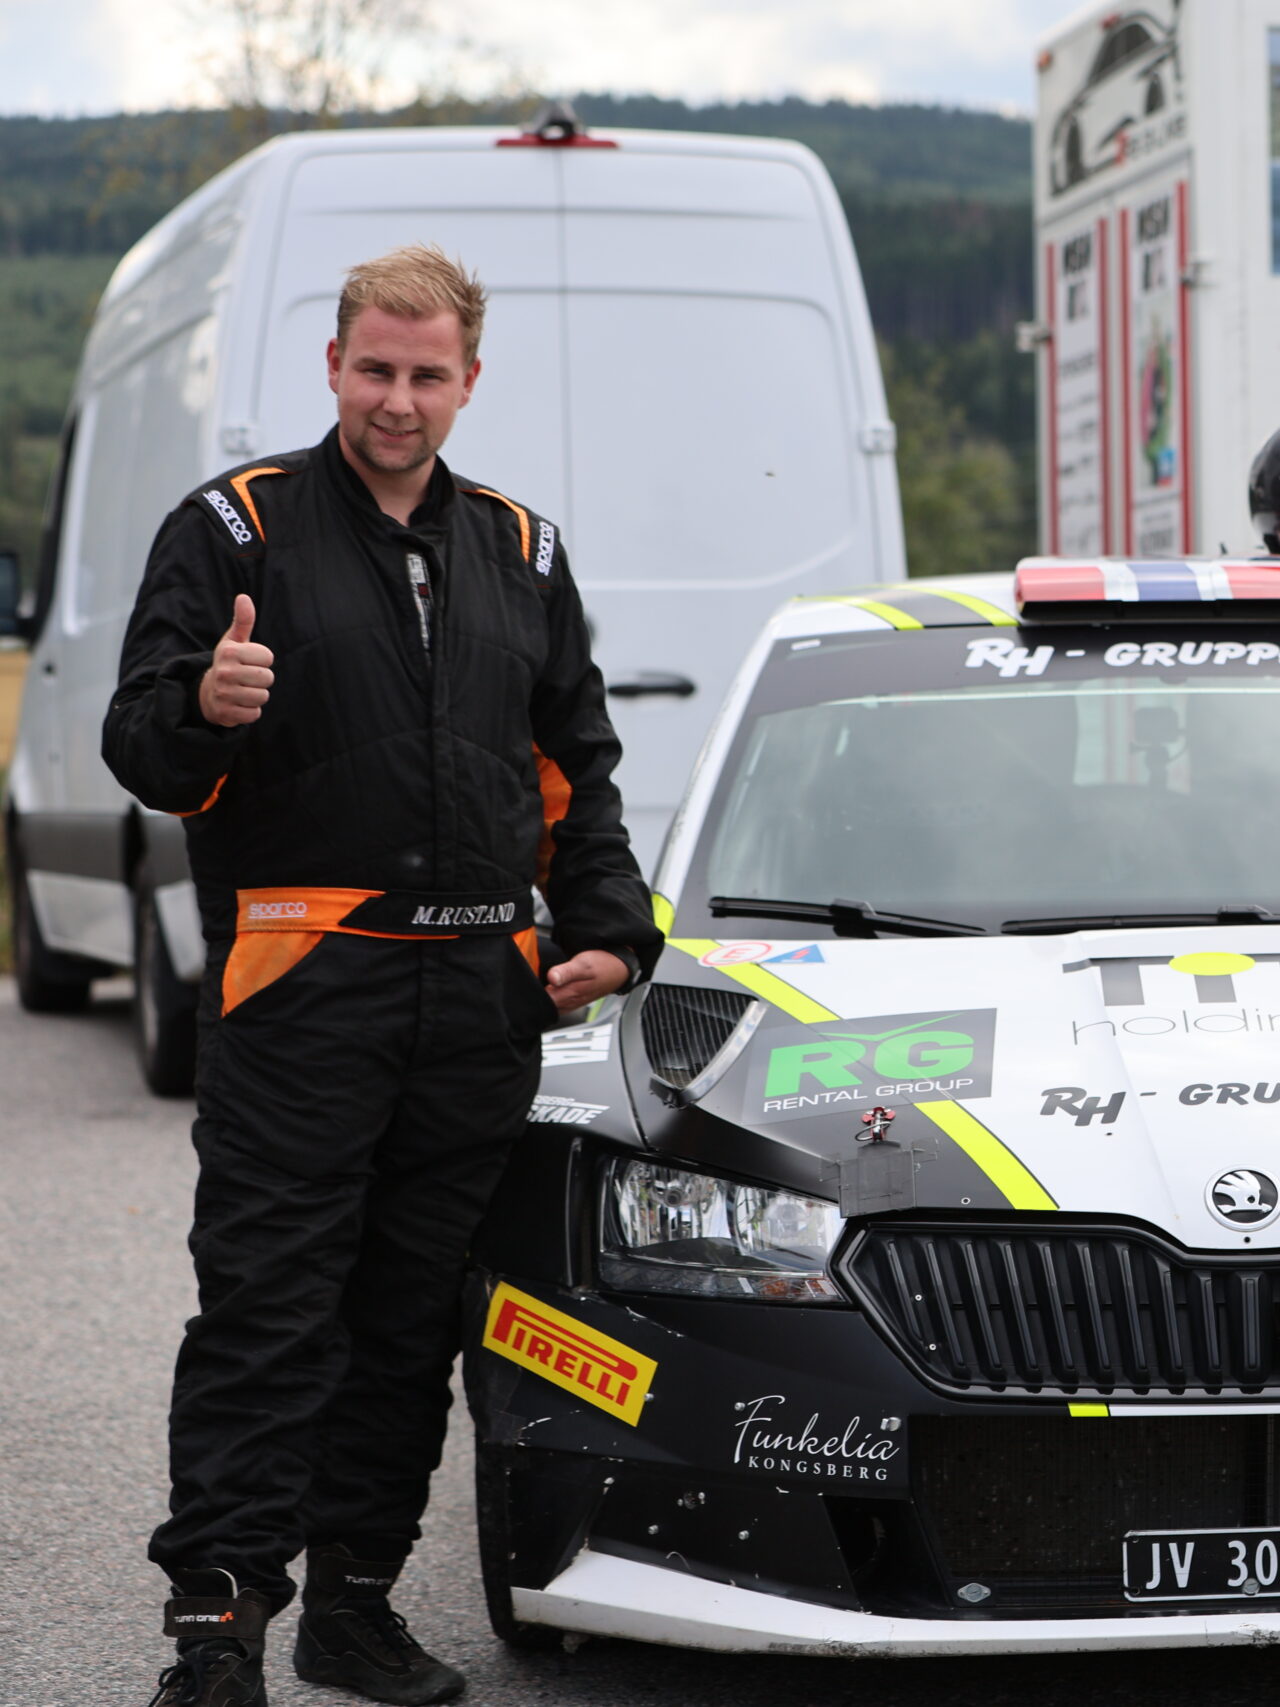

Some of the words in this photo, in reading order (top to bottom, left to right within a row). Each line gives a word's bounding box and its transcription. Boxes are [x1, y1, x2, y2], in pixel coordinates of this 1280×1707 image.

[203, 490, 252, 545] sparco
[536, 521, 554, 576] sparco
[965, 637, 1054, 678] RH
[249, 902, 307, 919] sparco
[412, 902, 516, 926] M.RUSTAND
[764, 1029, 975, 1098] RG
[763, 1087, 859, 1113] RENTAL
[875, 1078, 974, 1098] GROUP
[1039, 1086, 1126, 1127] RH
[491, 1299, 638, 1406] PIRELLI
[734, 1394, 900, 1463] Funkelia
[748, 1456, 888, 1481] KONGSBERG
[1146, 1541, 1195, 1590] JV
